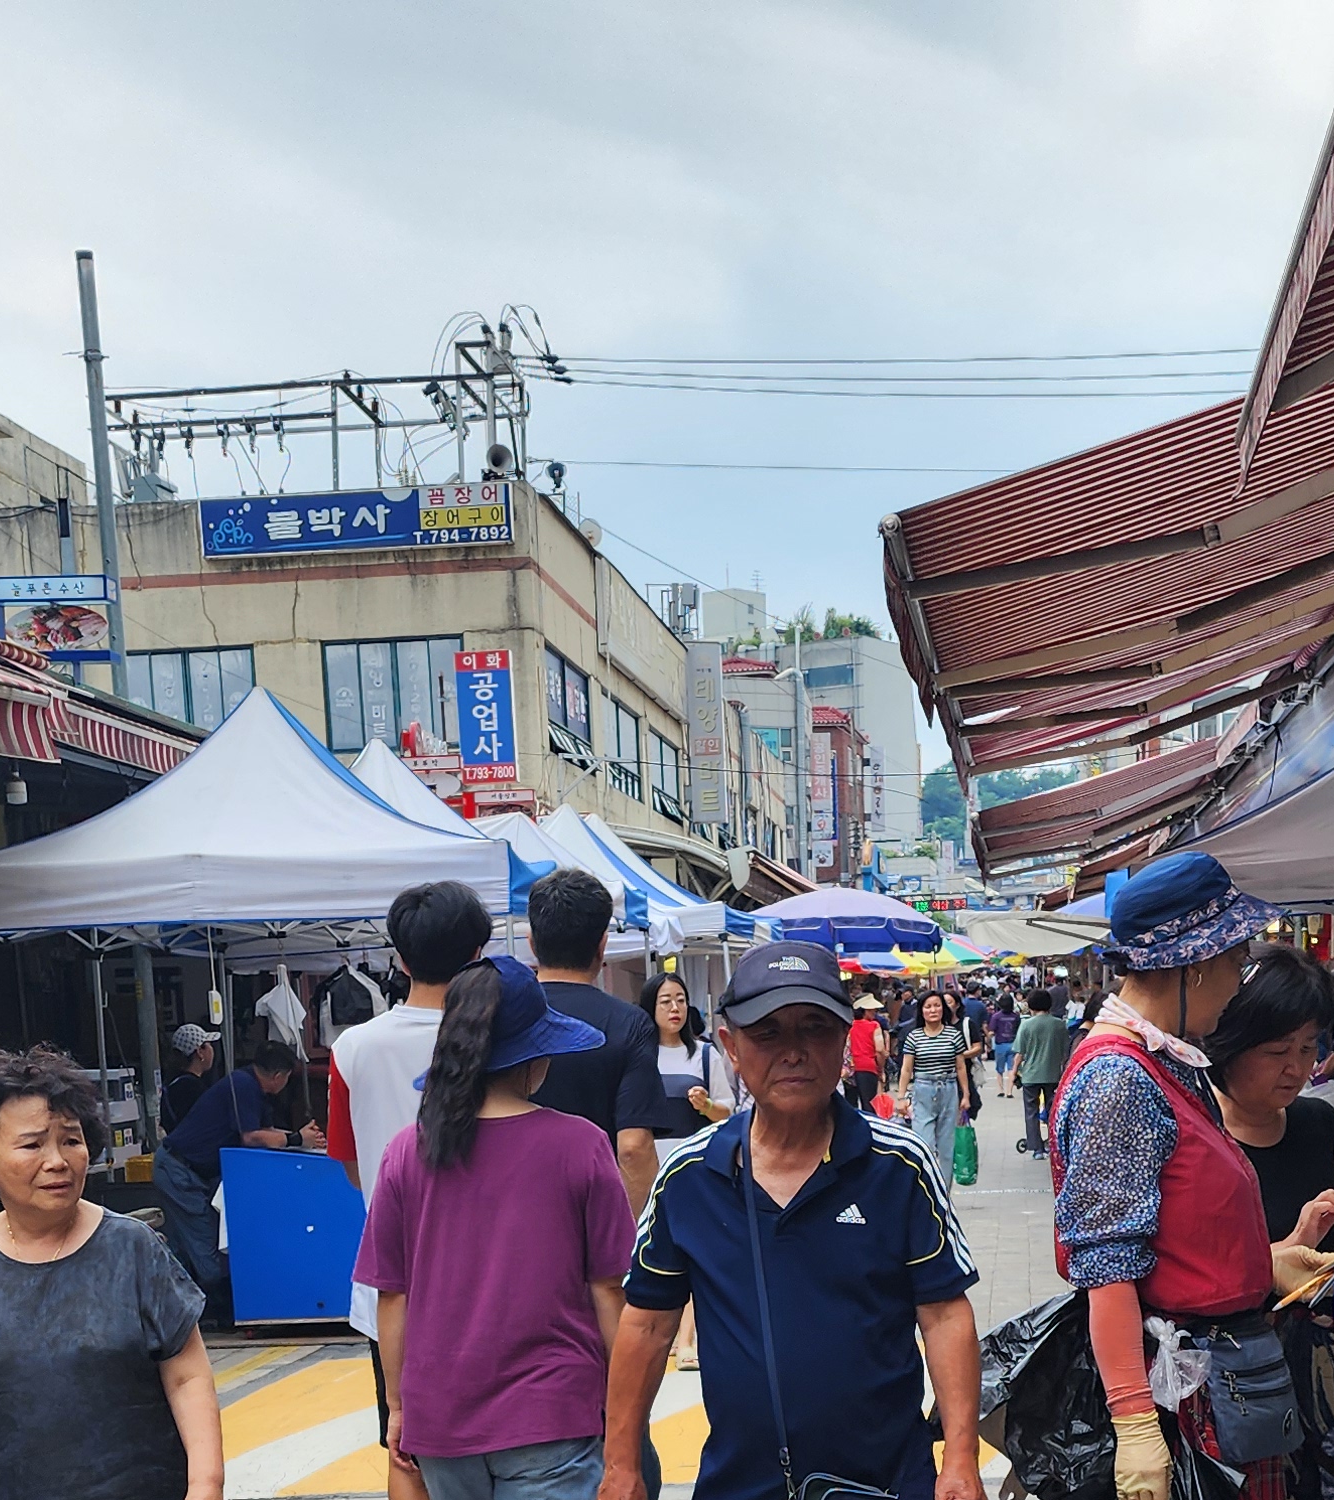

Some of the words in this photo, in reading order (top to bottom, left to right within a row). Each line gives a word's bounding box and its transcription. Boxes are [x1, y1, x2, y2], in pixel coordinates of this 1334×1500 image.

[427, 487, 499, 505] 꼼장어
[264, 503, 392, 541] 물박사
[423, 506, 505, 526] 장어구이
[413, 525, 510, 545] T.794-7892
[462, 652, 502, 670] 이화
[469, 672, 503, 762] 공업사
[464, 765, 515, 780] T.793-7800
[835, 1216, 867, 1225] adidas
